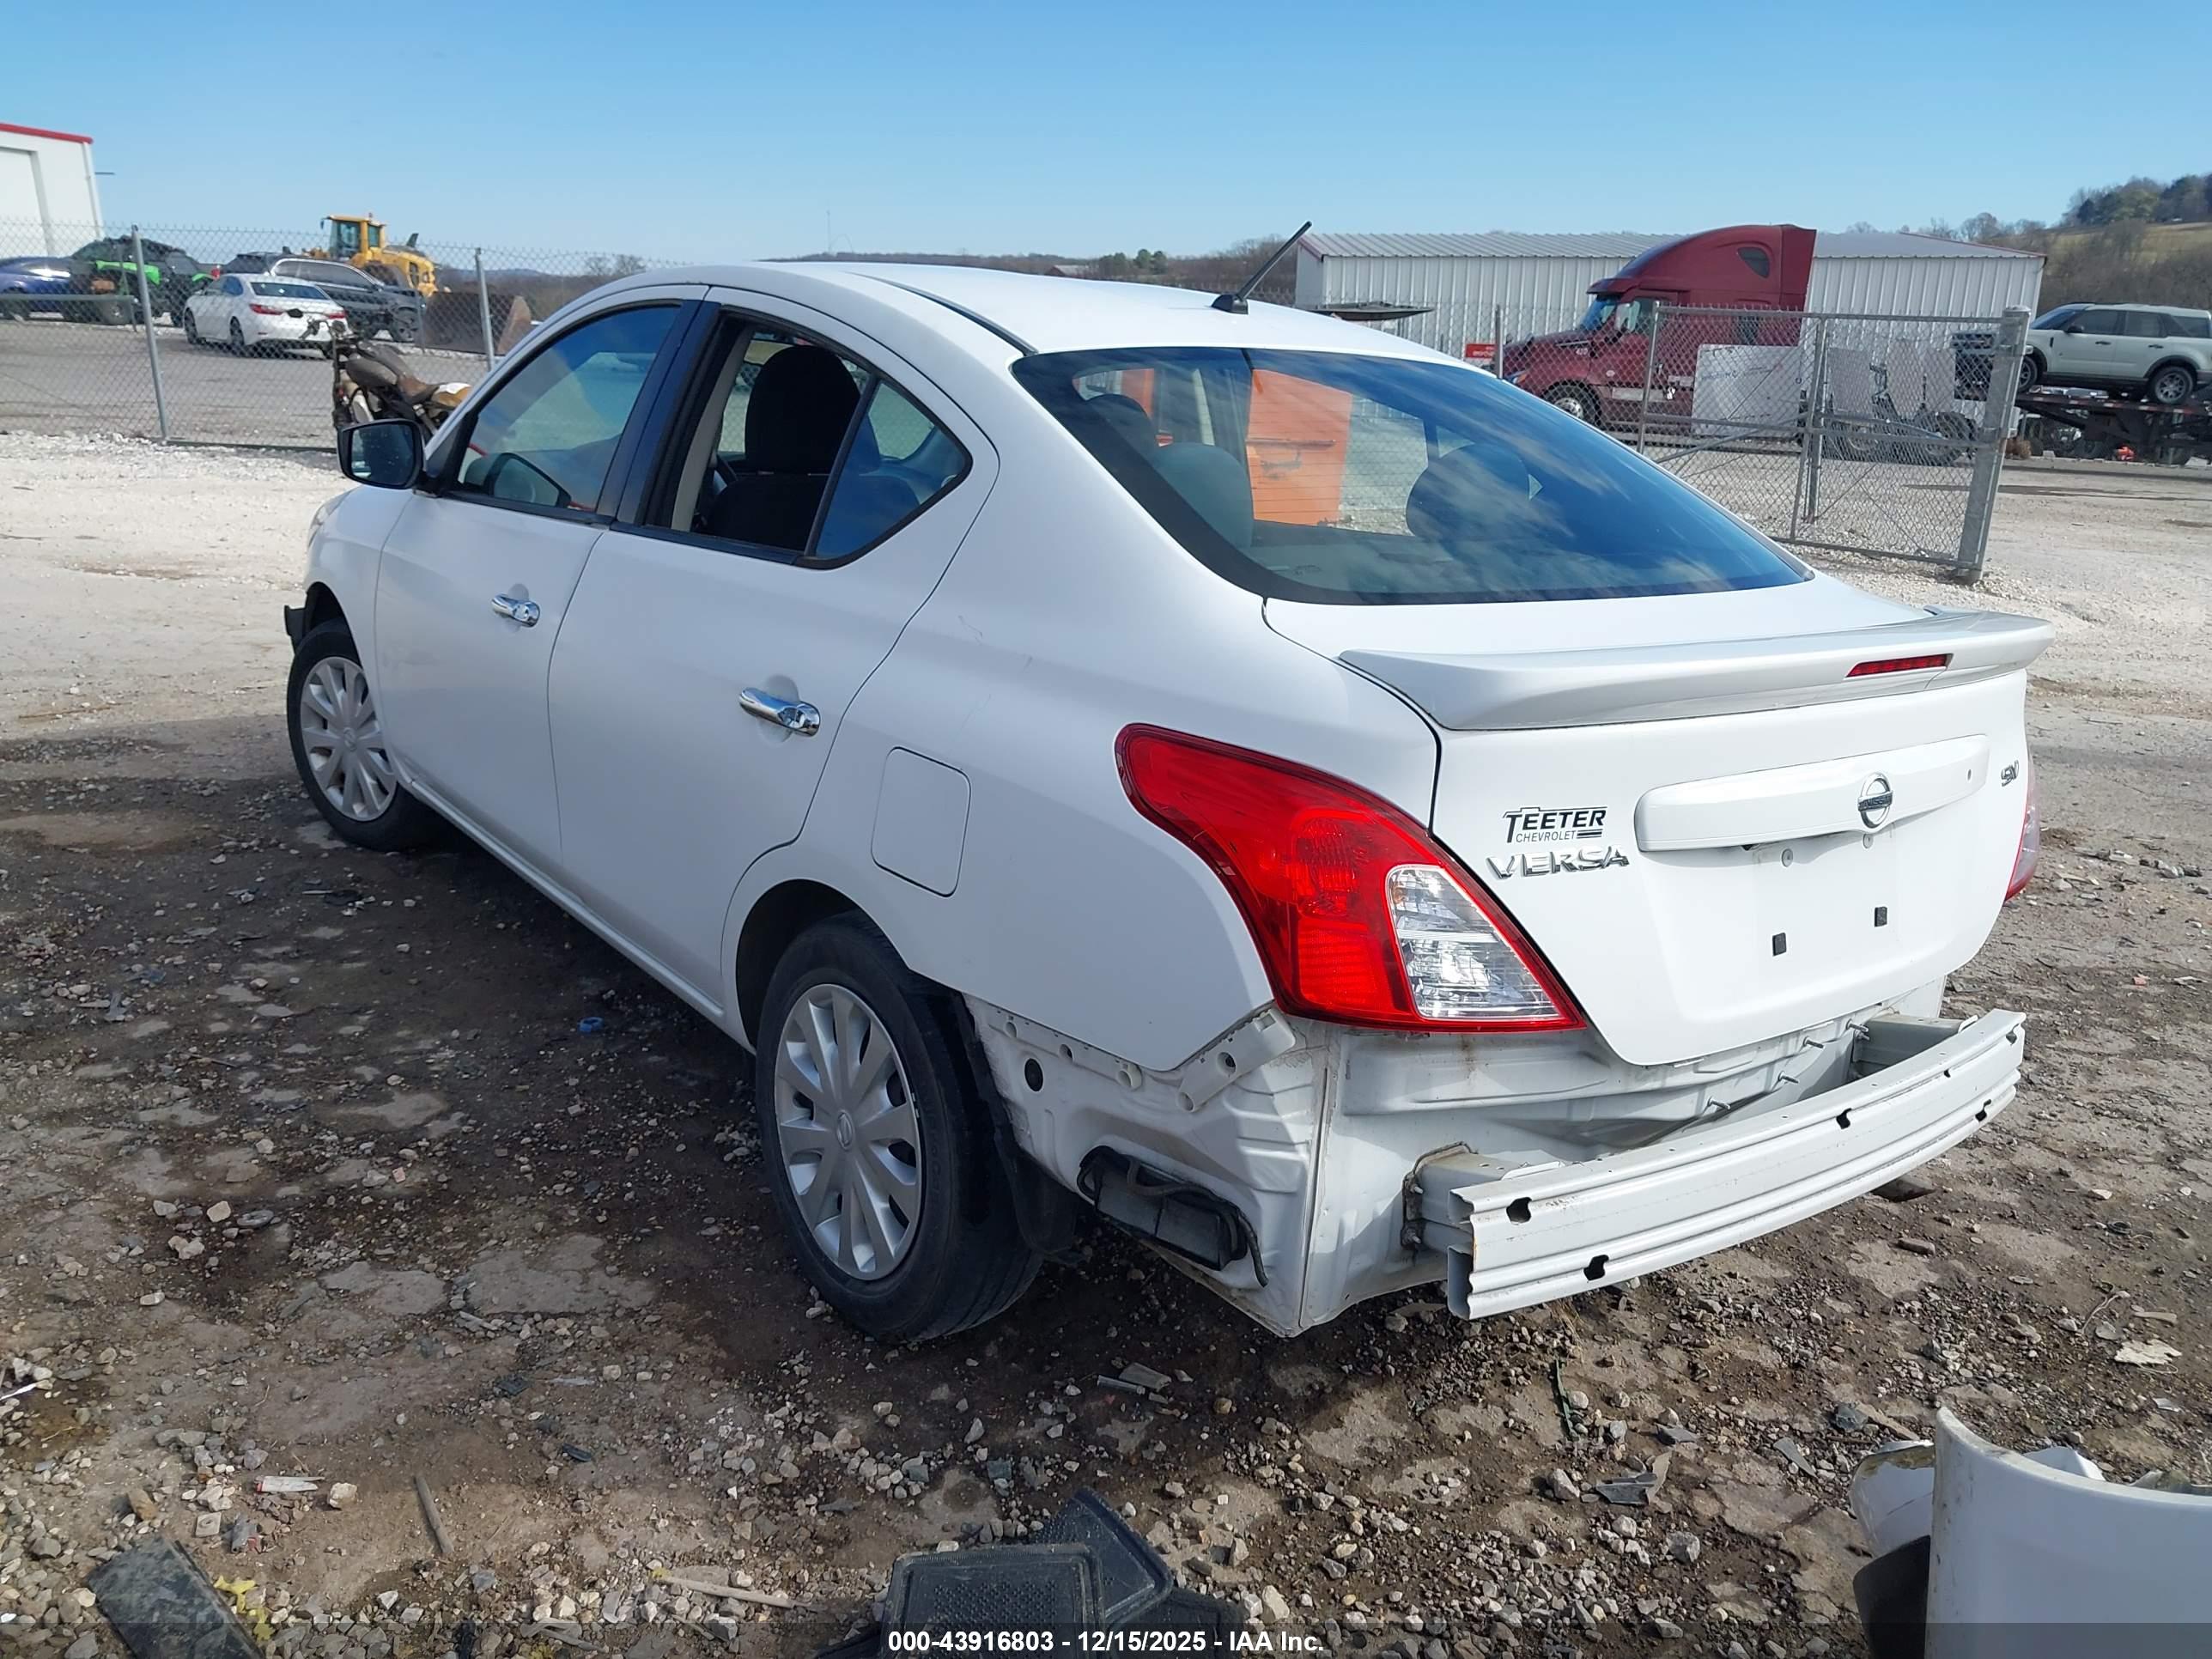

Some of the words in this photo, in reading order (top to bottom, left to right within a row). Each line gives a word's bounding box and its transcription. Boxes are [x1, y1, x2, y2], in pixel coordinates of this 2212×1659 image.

[2001, 760, 2020, 787] SV
[1505, 809, 1607, 843] TEETER
[1516, 830, 1577, 843] CHEVROLET
[1486, 845, 1630, 879] VERSA
